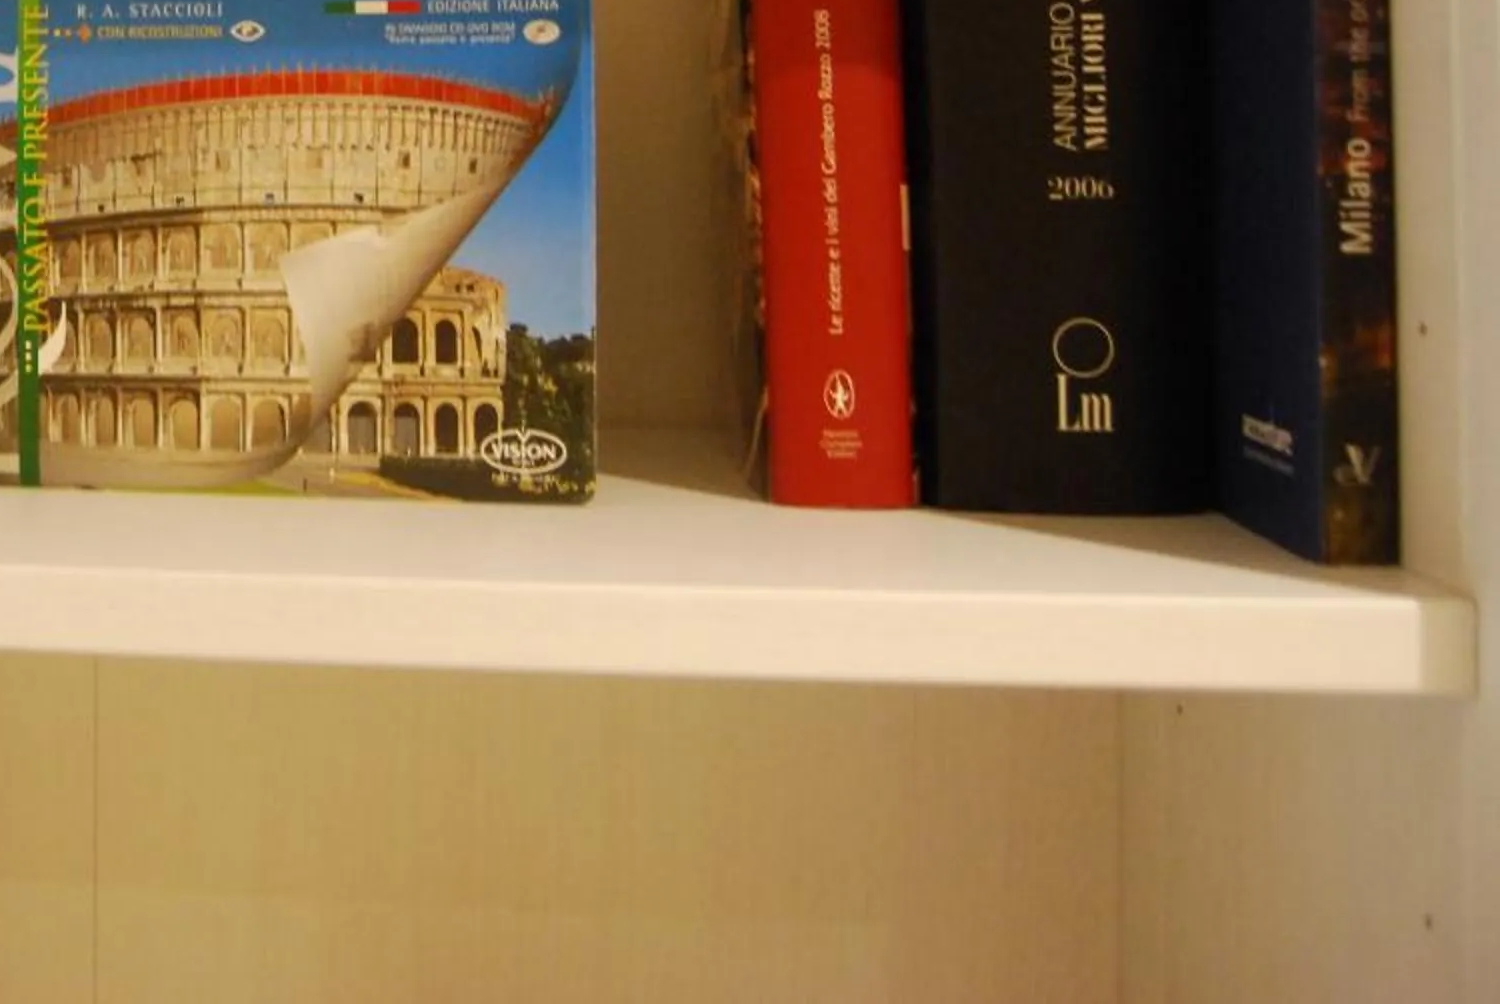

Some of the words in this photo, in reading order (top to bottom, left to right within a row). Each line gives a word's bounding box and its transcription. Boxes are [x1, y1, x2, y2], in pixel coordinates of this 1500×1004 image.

[102, 2, 120, 19] A.
[127, 0, 223, 20] STACCIOLI
[21, 4, 51, 161] PRESENTE
[1048, 2, 1079, 152] ANNUARIO
[1078, 14, 1109, 151] MIGLIORI
[22, 170, 49, 189] E
[821, 176, 840, 204] del
[1046, 176, 1115, 201] 2006
[1339, 137, 1373, 256] Milano
[22, 196, 51, 333] PASSATO
[827, 247, 841, 260] e
[827, 315, 844, 335] Le
[490, 440, 558, 462] VISION
